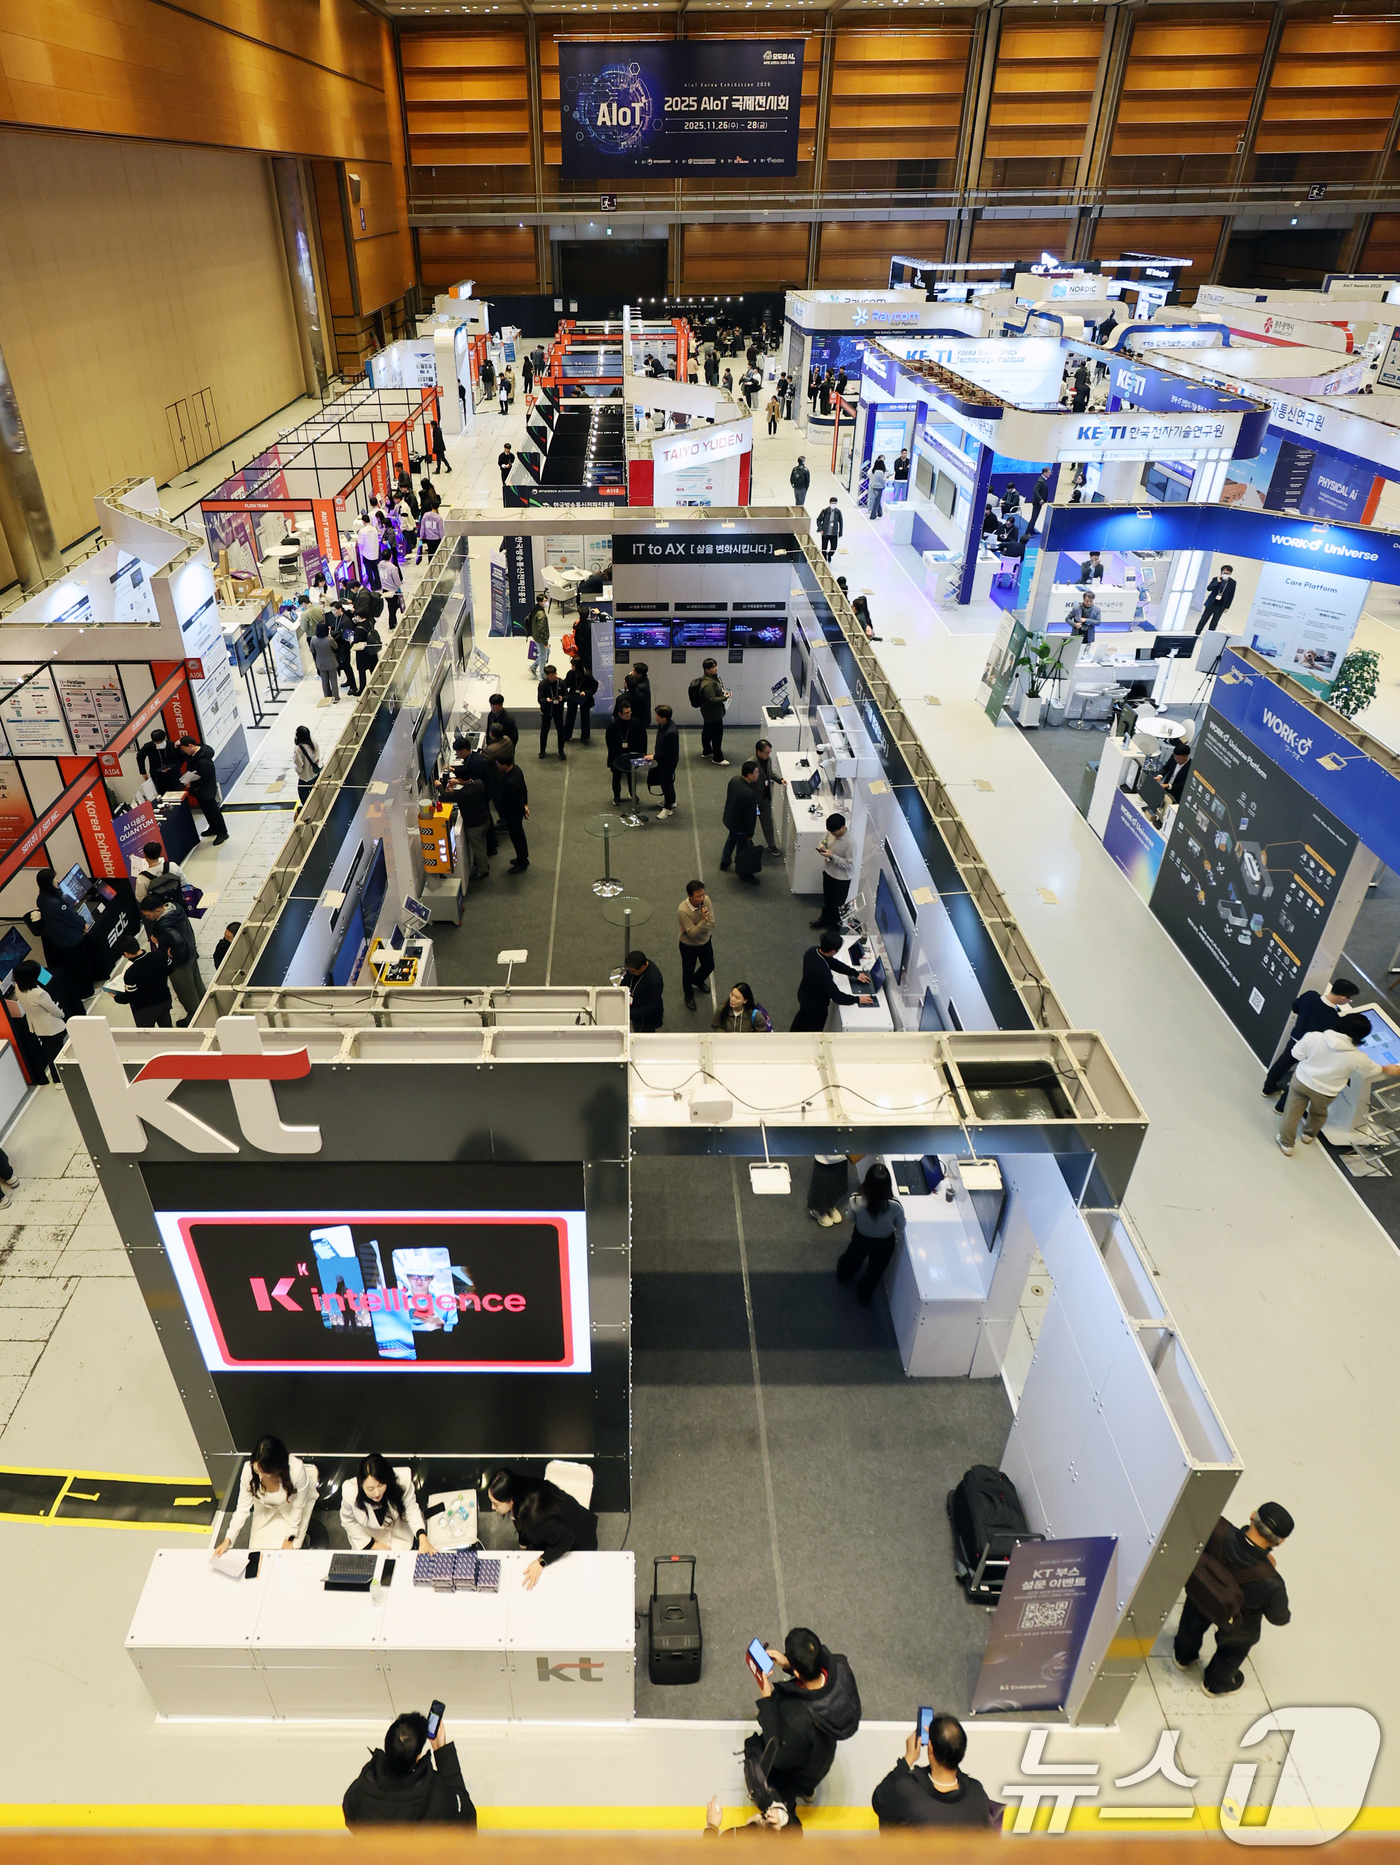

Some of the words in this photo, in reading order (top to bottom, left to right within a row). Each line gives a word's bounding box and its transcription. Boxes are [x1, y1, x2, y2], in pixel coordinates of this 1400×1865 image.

[664, 96, 698, 112] 2025
[700, 96, 729, 111] AIoT
[731, 95, 790, 112] 국제전시회
[597, 102, 645, 127] AIoT
[684, 120, 739, 131] 2025.11.26(수)
[747, 120, 768, 130] 28(금)
[1069, 285, 1097, 294] NORDIC
[872, 310, 920, 324] Raycom
[956, 356, 995, 364] Technology
[1116, 367, 1147, 397] KETI
[1076, 425, 1127, 441] KETI
[1129, 424, 1225, 440] 한국전자기술연구원
[662, 442, 700, 462] TAIYO
[702, 432, 744, 450] YUDEN
[1142, 452, 1173, 460] Technology
[376, 463, 384, 482] Korea
[1317, 475, 1350, 498] PHYSICAL
[1349, 489, 1359, 501] Ai
[320, 510, 330, 532] AIoT
[323, 533, 334, 550] Korea
[632, 543, 646, 555] IT
[647, 543, 662, 555] to
[664, 543, 686, 555] AX
[696, 544, 714, 554] 삶을
[715, 544, 767, 554] 변화시킵니다
[1324, 543, 1379, 562] Universe
[1285, 578, 1302, 587] Care
[1304, 581, 1338, 594] Platform
[172, 701, 185, 729] Korea
[1228, 738, 1248, 761] Universe
[1246, 756, 1268, 780] Platform
[104, 768, 120, 776] A104
[84, 800, 101, 832] Korea
[22, 832, 39, 854] SDT(주)
[42, 820, 52, 832] SDT
[119, 818, 154, 843] QUANTUM
[123, 824, 131, 832] AI
[66, 1015, 324, 1154] kt
[312, 1286, 526, 1317] intelligence
[1022, 1580, 1046, 1591] 설문
[1048, 1576, 1087, 1590] 이벤트
[1032, 1569, 1054, 1580] KT
[1055, 1568, 1081, 1578] 부스
[536, 1656, 605, 1683] kt
